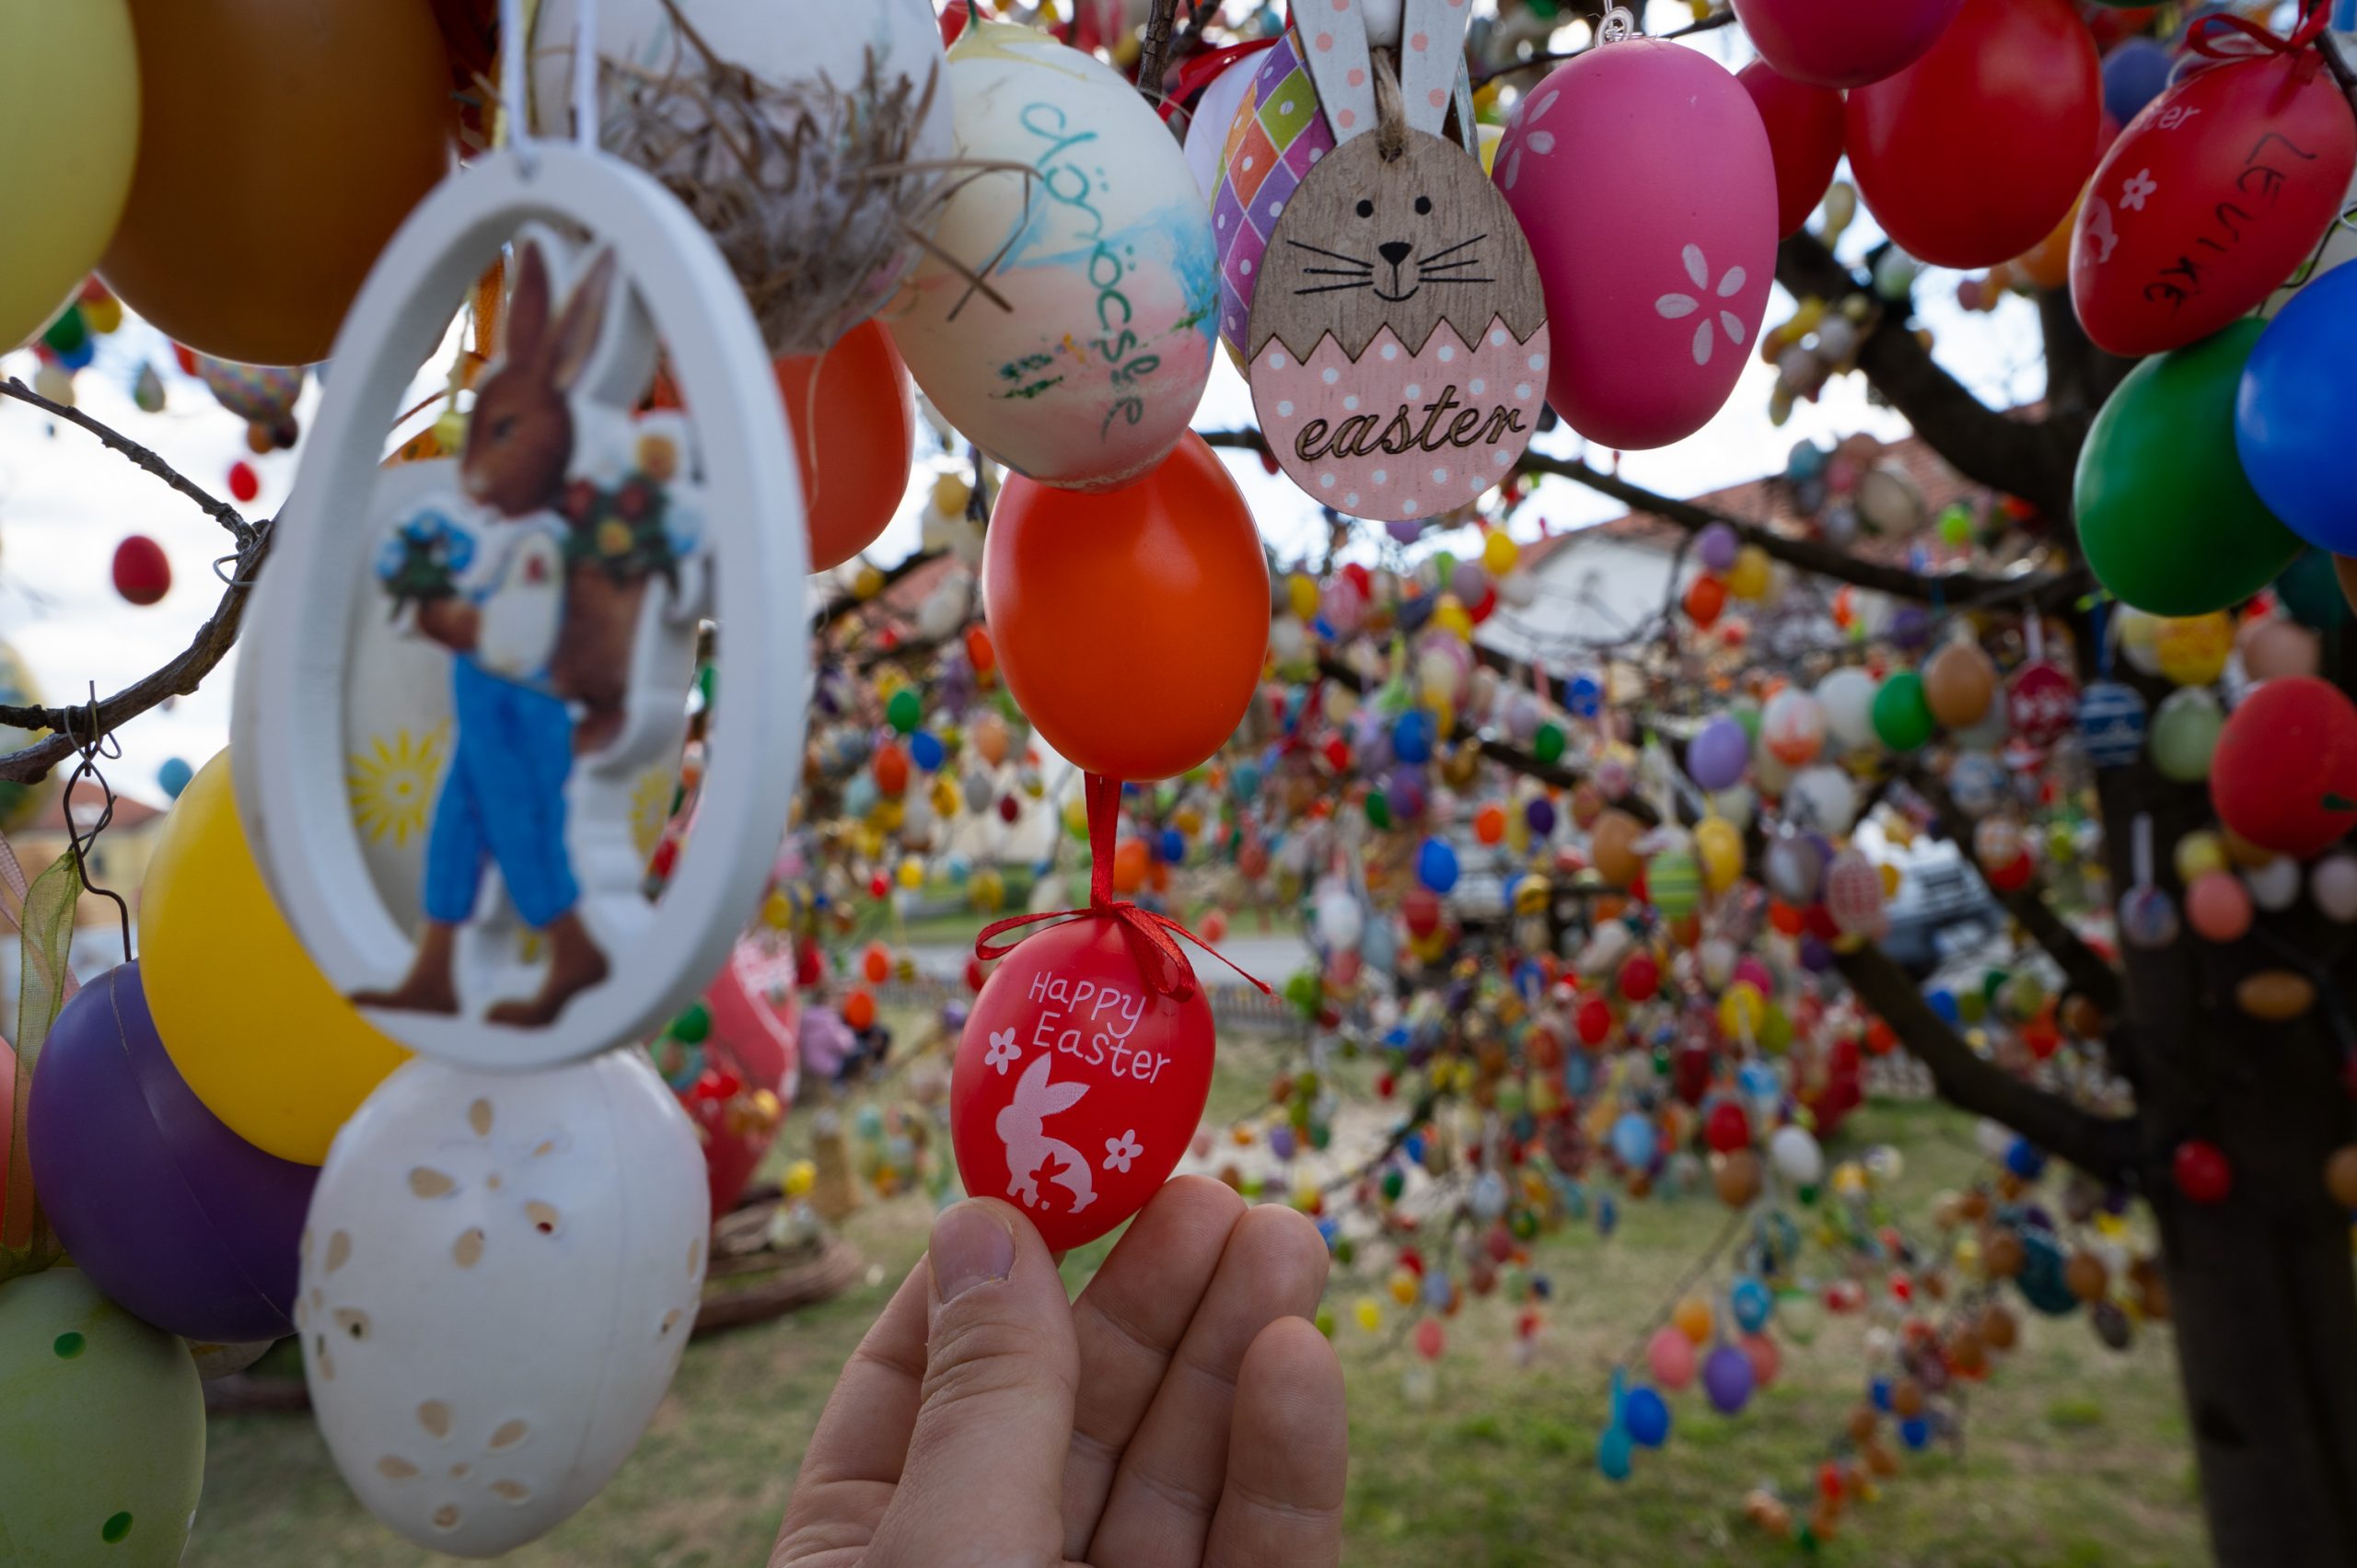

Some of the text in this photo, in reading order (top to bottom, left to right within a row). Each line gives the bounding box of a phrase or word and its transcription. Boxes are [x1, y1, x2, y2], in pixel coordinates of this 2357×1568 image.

[1295, 385, 1527, 460] easter
[1028, 971, 1146, 1039] Happy
[1032, 1011, 1170, 1083] Easter
